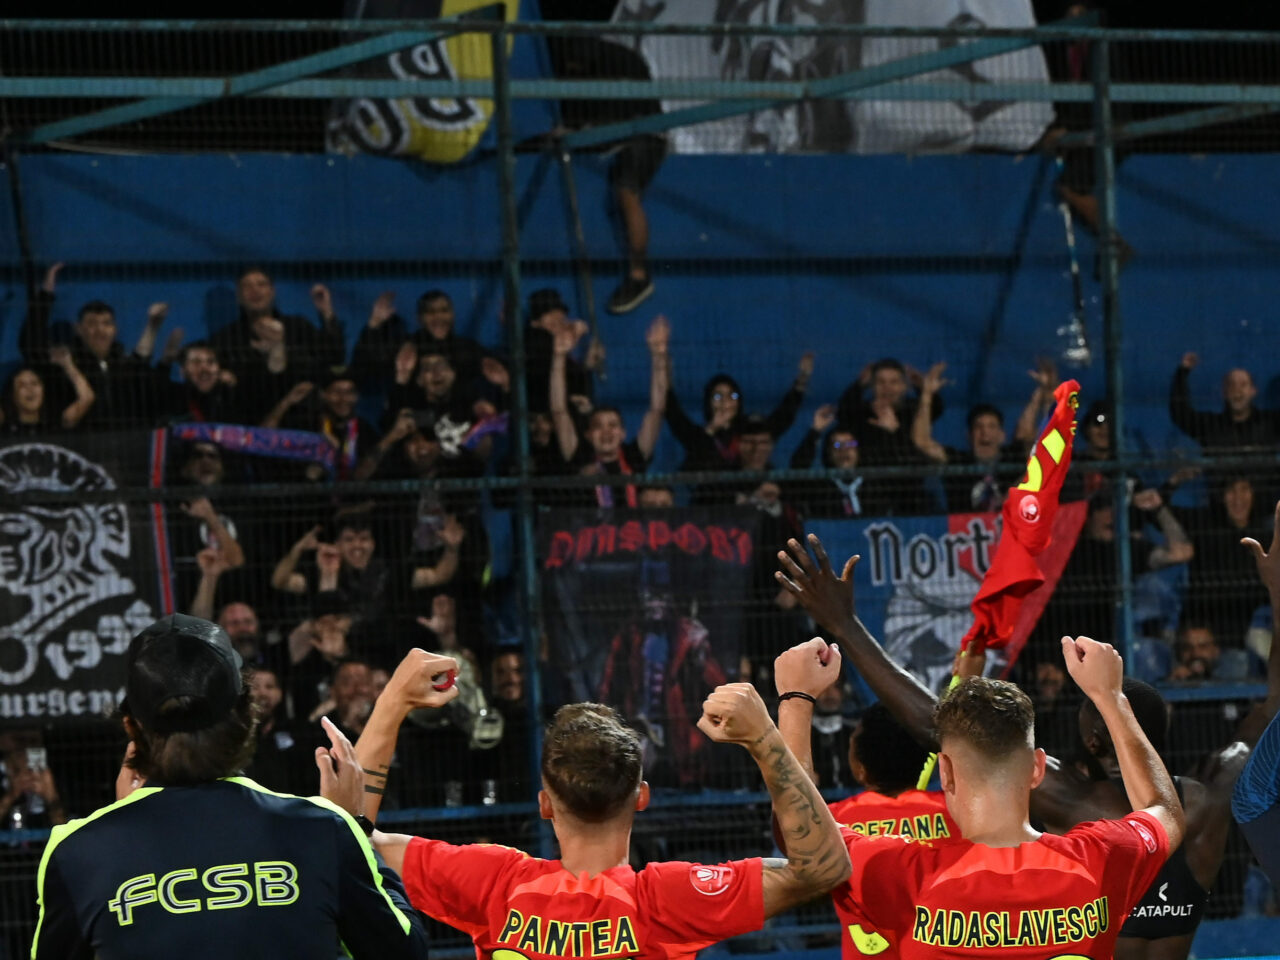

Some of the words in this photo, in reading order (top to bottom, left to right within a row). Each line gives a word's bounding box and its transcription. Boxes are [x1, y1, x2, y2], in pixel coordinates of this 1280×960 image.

[863, 514, 1003, 586] Nort
[108, 861, 300, 926] FCSB
[912, 896, 1109, 948] RADASLAVESCU
[497, 908, 640, 957] PANTEA
